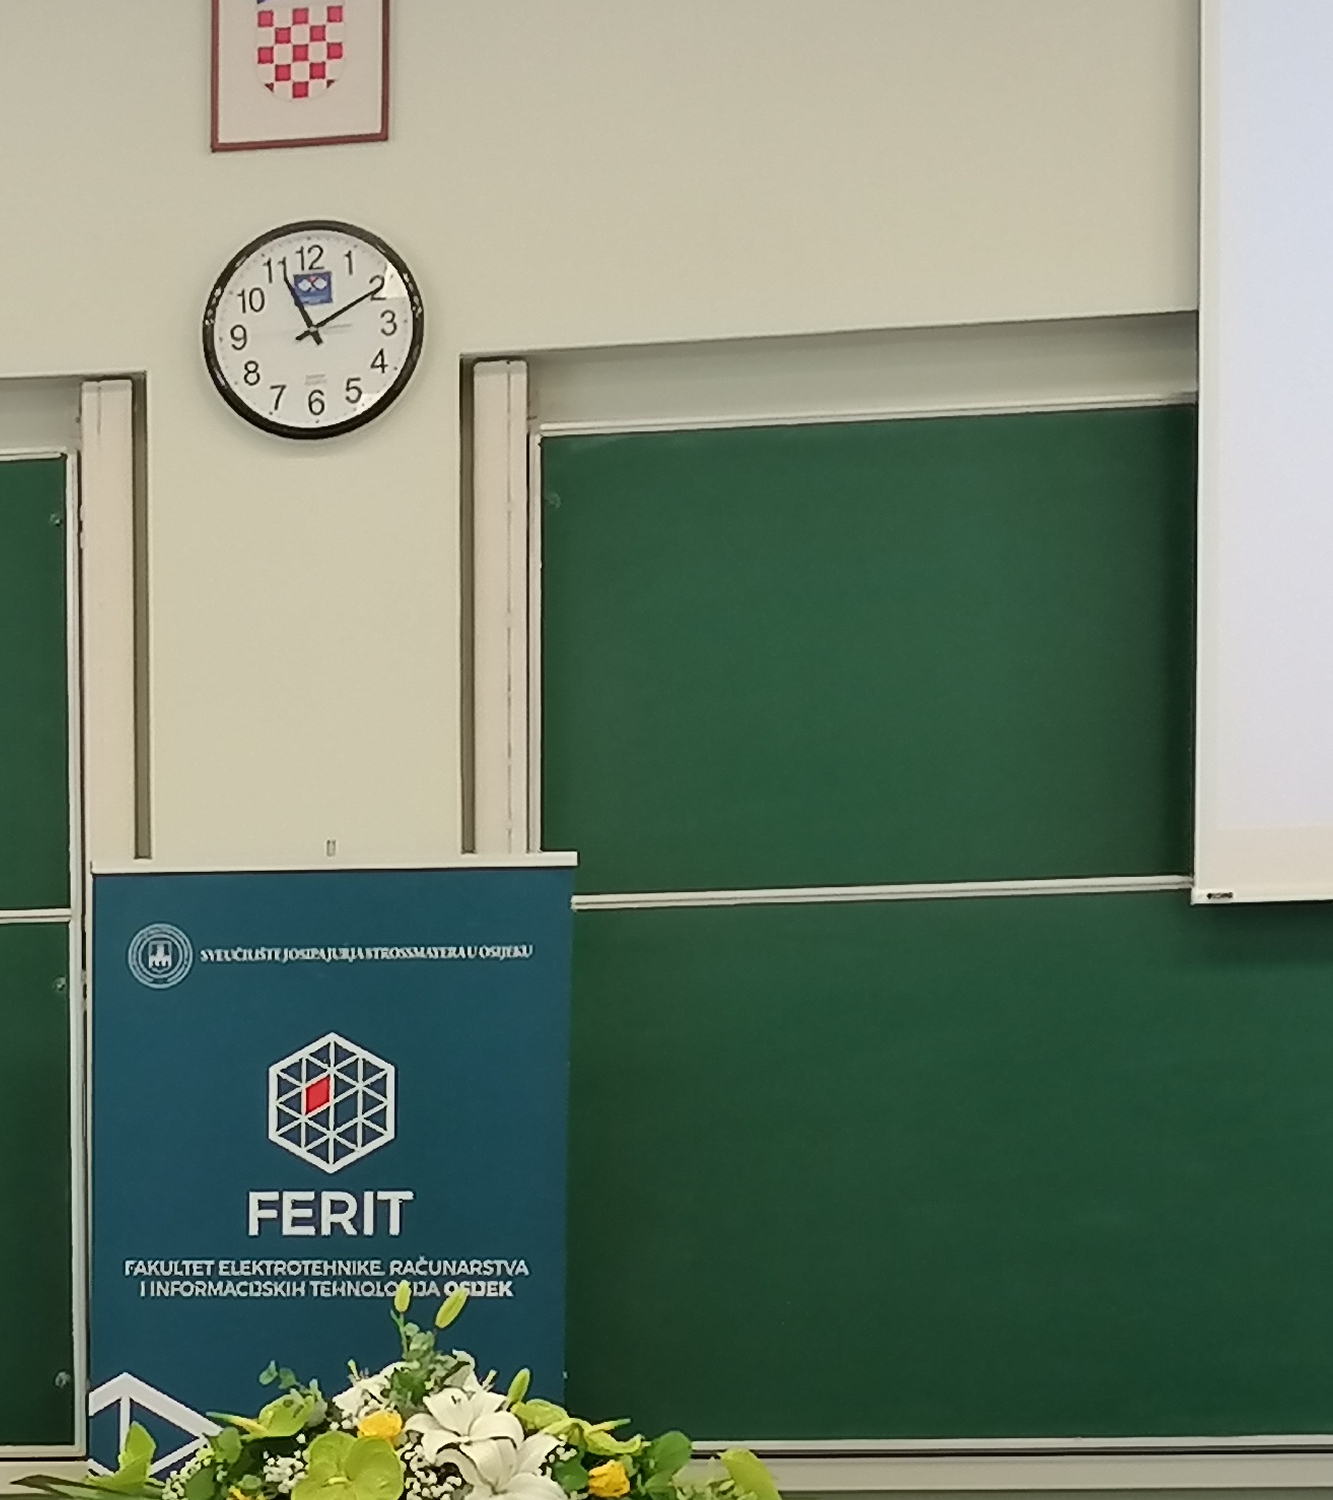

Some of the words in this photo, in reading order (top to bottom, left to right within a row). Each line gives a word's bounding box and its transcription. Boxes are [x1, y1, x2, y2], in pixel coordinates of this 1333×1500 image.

[296, 245, 325, 271] 12
[345, 250, 353, 276] 1
[238, 287, 265, 313] 10
[369, 275, 386, 301] 2
[380, 310, 397, 336] 3
[230, 324, 247, 350] 9
[243, 360, 261, 386] 8
[370, 348, 388, 374] 4
[270, 385, 287, 411] 7
[307, 389, 325, 415] 6
[345, 377, 362, 403] 5
[246, 1190, 414, 1237] FERIT
[124, 1259, 215, 1277] FAKULTET
[389, 1255, 530, 1277] RAČUNARSTVA
[140, 1280, 146, 1298] I
[150, 1280, 306, 1298] INFORMACIJSKIH
[309, 1280, 441, 1298] TEHNOLOIJA
